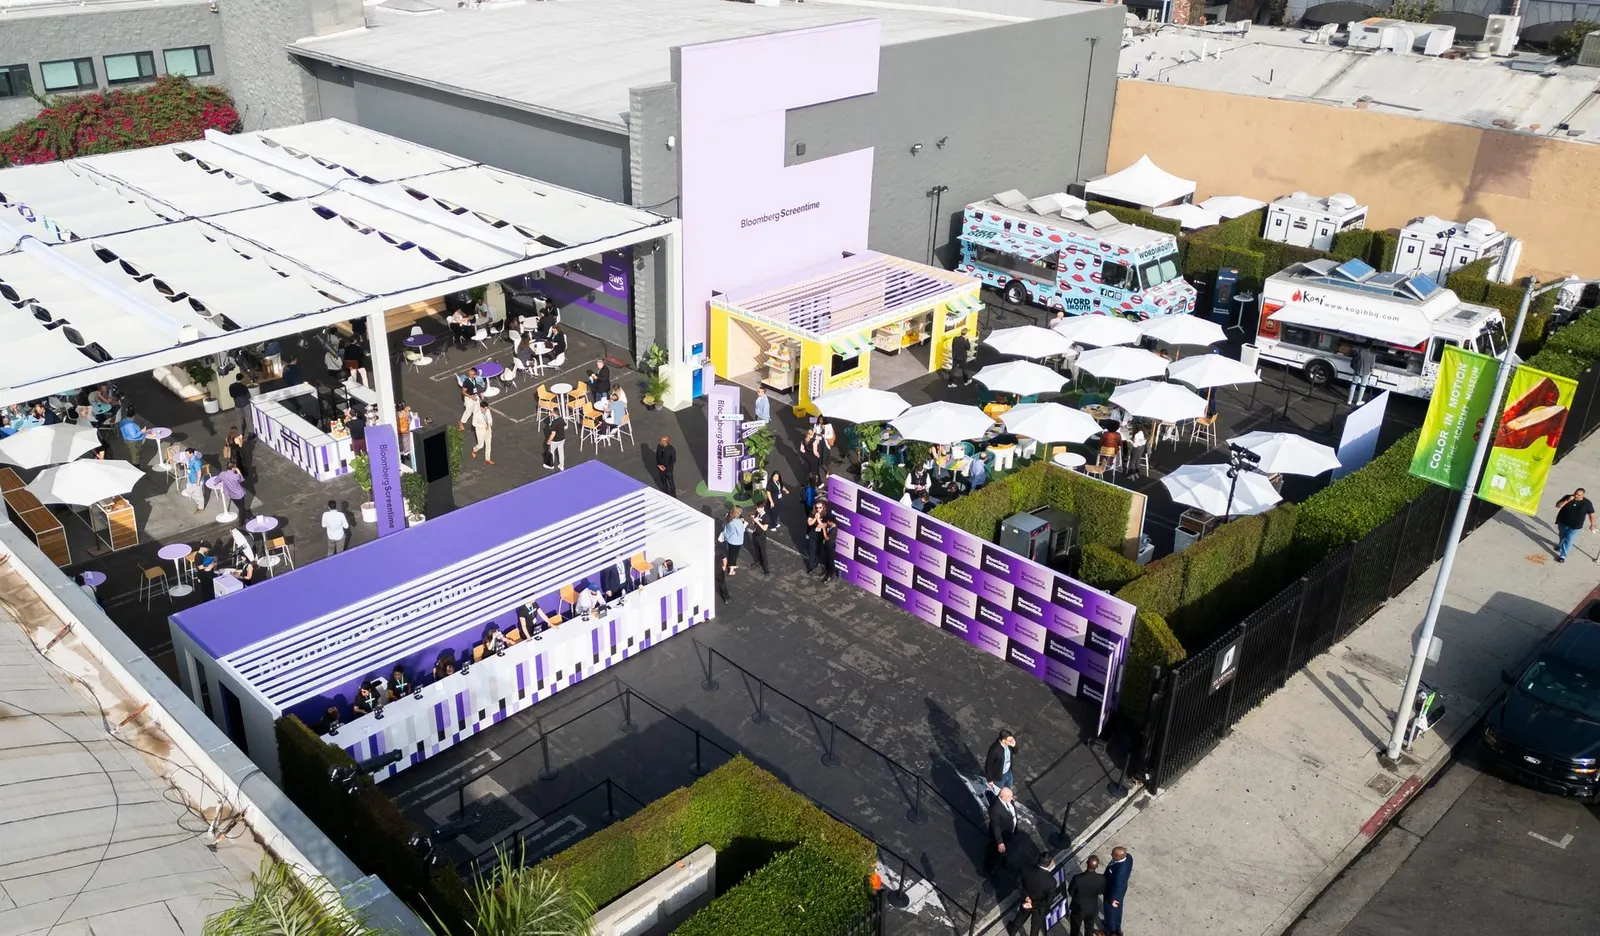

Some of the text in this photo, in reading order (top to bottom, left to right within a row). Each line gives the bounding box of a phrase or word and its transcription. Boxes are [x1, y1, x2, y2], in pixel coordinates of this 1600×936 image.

[740, 201, 820, 228] Bloomberg Screentime
[1138, 248, 1156, 258] WORD
[1324, 302, 1400, 322] www.kogibbq.com
[1430, 362, 1468, 469] COLOR IN MOTION
[1444, 366, 1479, 474] AT THE ACADEMY MUSEUM
[380, 444, 394, 529] Bloomberg Screentime
[861, 499, 880, 512] Bloomberg
[861, 503, 881, 516] Screentime
[921, 526, 942, 540] Bloomberg
[921, 530, 943, 544] Screentime
[888, 541, 909, 554] Screentime
[889, 536, 908, 550] Bloomberg
[858, 546, 877, 560] Bloomberg
[858, 551, 878, 564] Screentime
[986, 555, 1009, 570] Bloomberg
[986, 559, 1010, 574] Screentime
[950, 565, 972, 580] Bloomberg
[950, 570, 973, 584] Screentime
[917, 575, 937, 589] Bloomberg
[917, 579, 938, 593] Screentime
[885, 588, 906, 602] Screentime
[886, 584, 905, 598] Bloomberg
[1057, 587, 1082, 603] Bloomberg
[1018, 596, 1041, 612] Bloomberg
[1057, 592, 1083, 607] Screentime
[981, 606, 1003, 621] Bloomberg
[1017, 601, 1042, 616] Screentime
[946, 614, 967, 629] Bloomberg
[980, 610, 1004, 625] Screentime
[946, 618, 968, 633] Screentime
[1012, 647, 1034, 663] Bloomberg
[1050, 639, 1074, 656] Bloomberg
[1050, 644, 1075, 660] Screentime
[1011, 651, 1035, 667] Screentime
